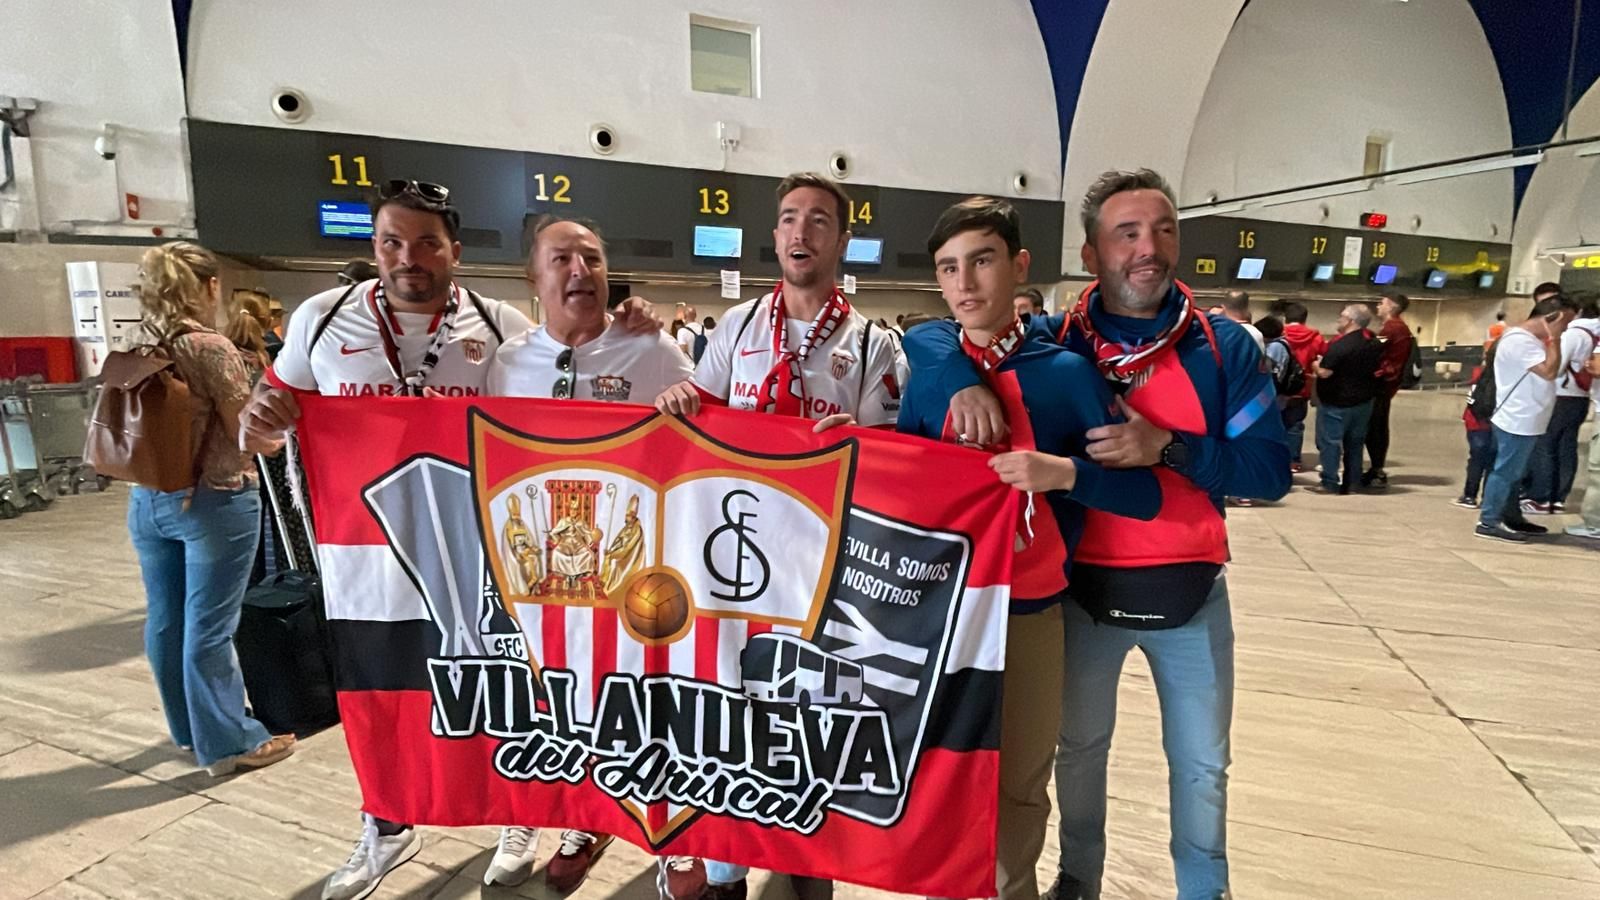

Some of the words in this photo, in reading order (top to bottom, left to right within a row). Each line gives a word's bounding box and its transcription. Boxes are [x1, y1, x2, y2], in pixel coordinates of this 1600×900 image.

[328, 154, 372, 186] 11
[534, 173, 571, 203] 12
[699, 188, 730, 215] 13
[848, 200, 872, 225] 14
[1238, 230, 1255, 249] 16
[1311, 237, 1327, 254] 17
[1372, 241, 1386, 258] 18
[1426, 247, 1440, 262] 19
[896, 556, 951, 582] SOMOS
[841, 566, 922, 607] NOSOTROS
[494, 636, 523, 658] SFC
[429, 660, 901, 793] VILLANUEVA
[497, 731, 585, 780] del
[596, 742, 830, 832] Ariscal
